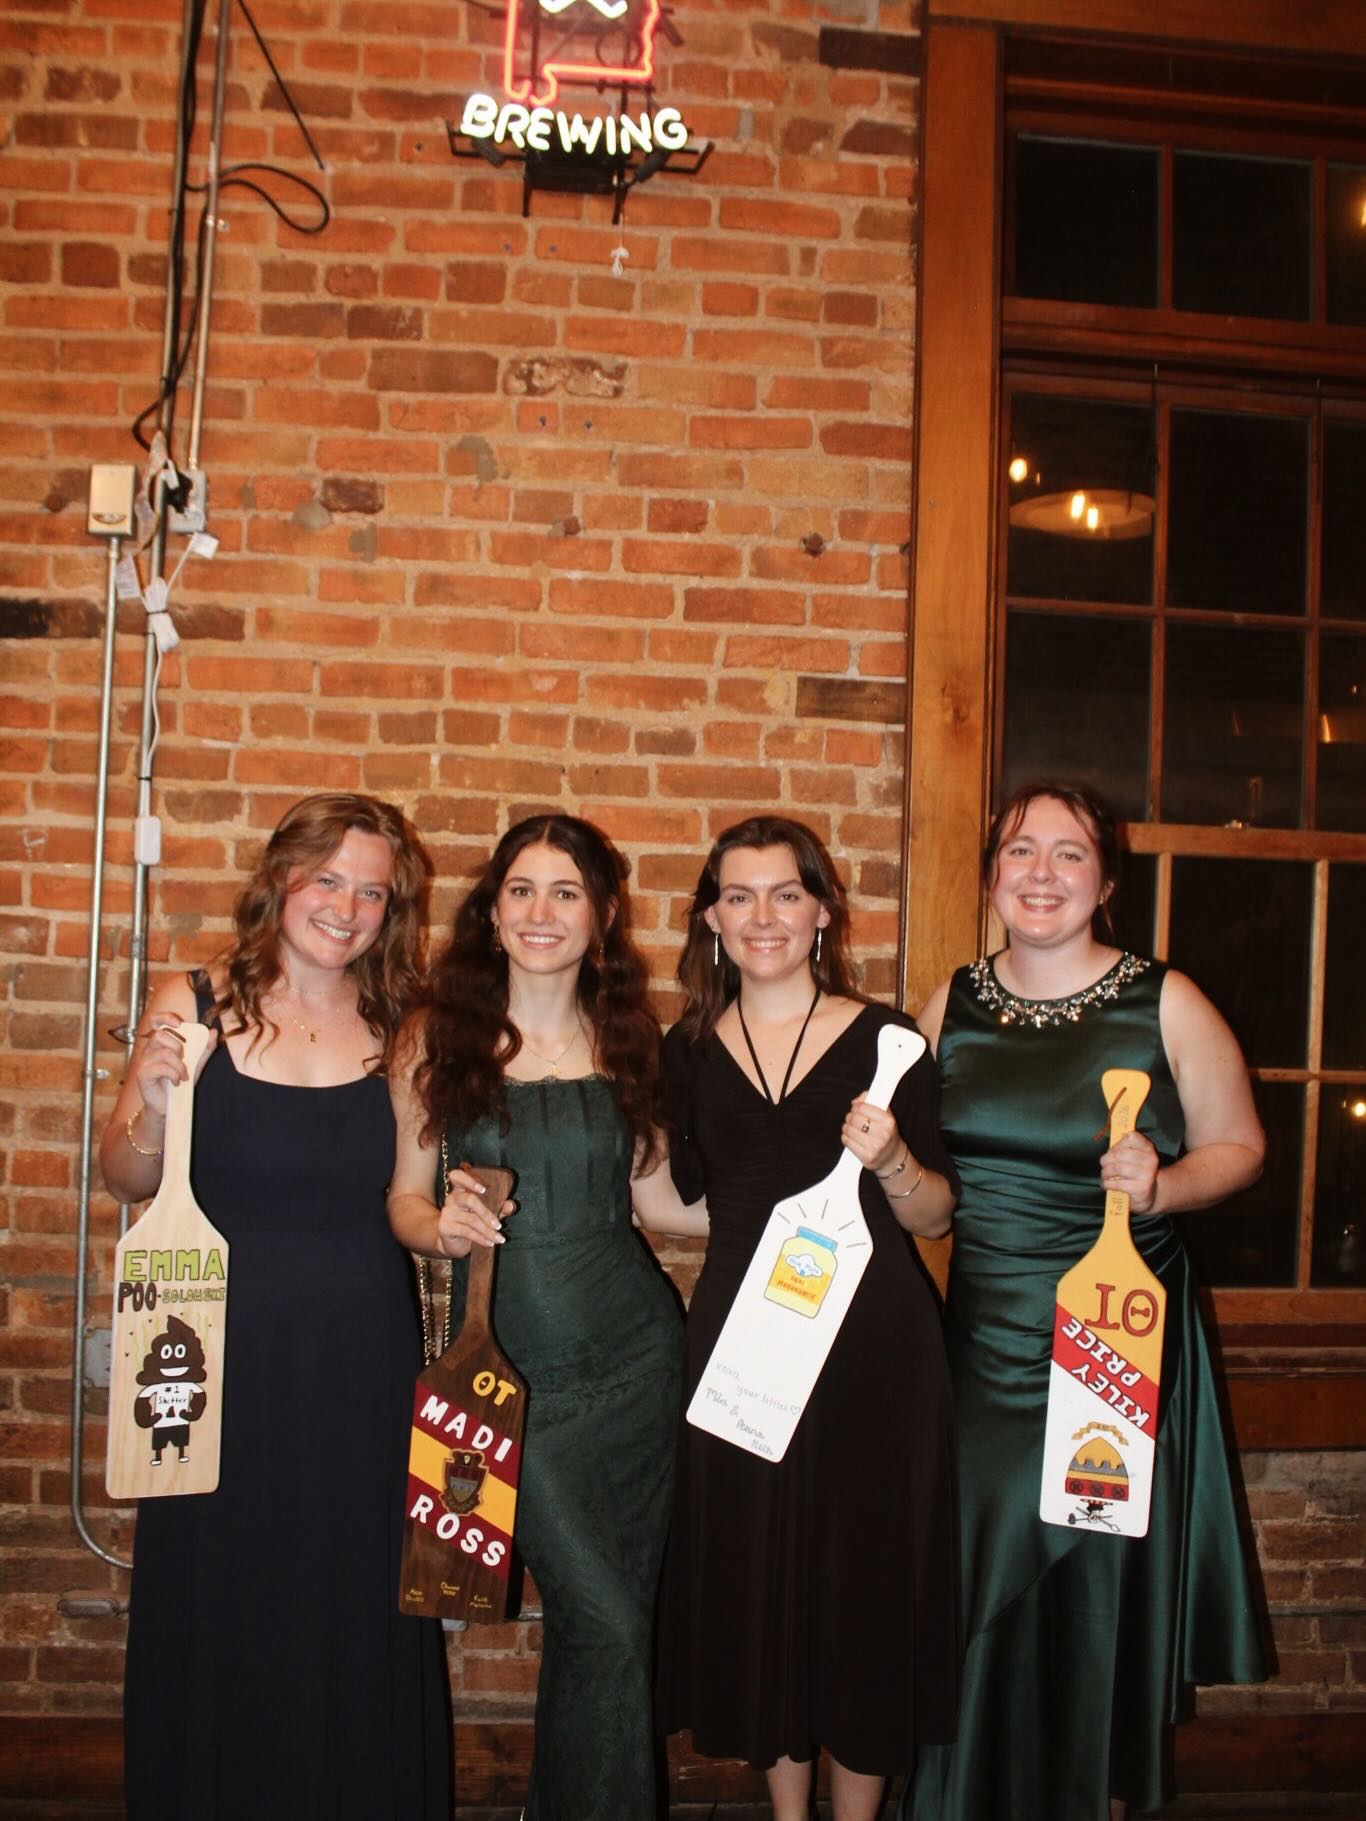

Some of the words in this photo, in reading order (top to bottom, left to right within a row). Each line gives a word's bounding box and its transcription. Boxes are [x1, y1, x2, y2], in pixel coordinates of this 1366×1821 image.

[461, 94, 688, 155] BREWING
[123, 1249, 225, 1281] EMMA
[1061, 1318, 1143, 1387] PRICE
[419, 1395, 513, 1462] MADI
[1072, 1363, 1150, 1428] KILEY
[410, 1494, 506, 1567] ROSS
